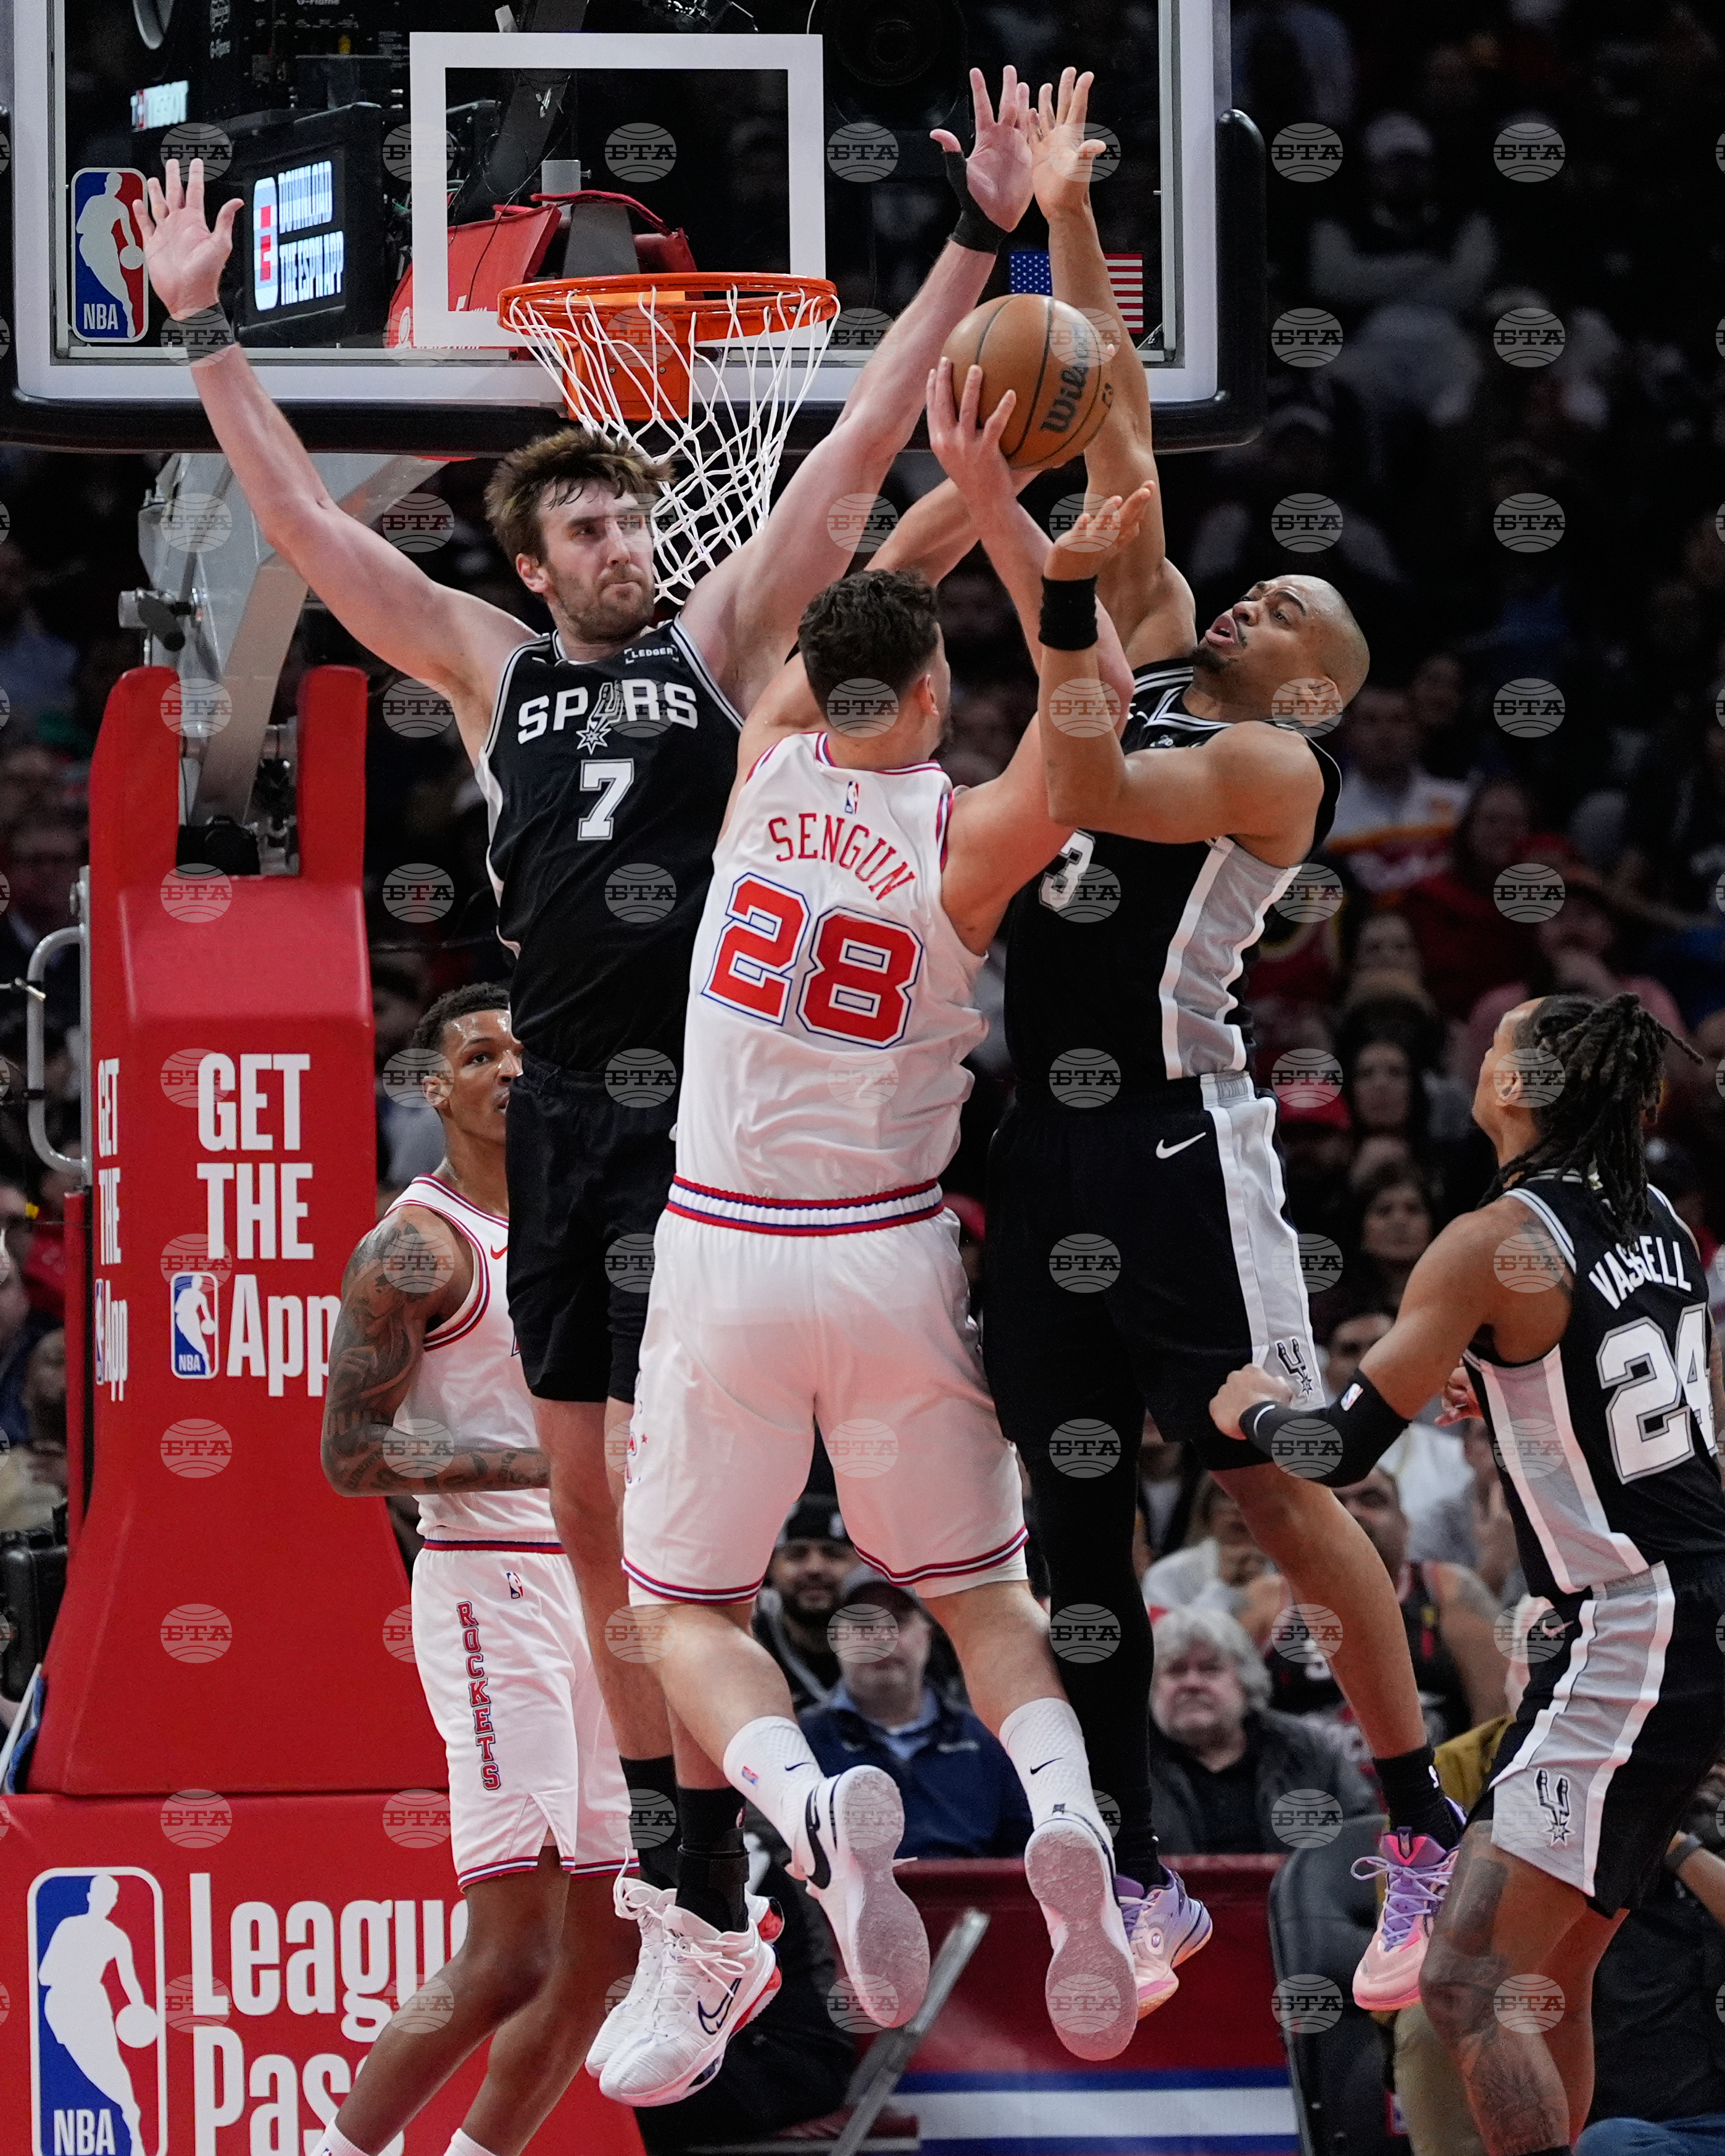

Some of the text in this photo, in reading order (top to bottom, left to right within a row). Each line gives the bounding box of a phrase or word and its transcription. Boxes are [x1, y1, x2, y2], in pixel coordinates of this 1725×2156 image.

[83, 303, 118, 330] NBA
[631, 646, 673, 658] LEDGER
[577, 758, 634, 840] 7
[768, 813, 916, 901] SENGUN
[701, 872, 924, 1049] 28
[98, 1058, 120, 1158] GET
[197, 1053, 310, 1151] GET
[98, 1167, 122, 1266] THE
[197, 1163, 314, 1259] THE
[1588, 1235, 1692, 1310] VASSELL
[105, 1279, 128, 1402] App
[178, 1354, 201, 1372] NBA
[226, 1274, 342, 1397] App
[1596, 1301, 1719, 1485] 24
[457, 1601, 501, 1791] ROCKETS
[53, 2108, 116, 2156] NBA
[193, 2025, 405, 2156] Pas
